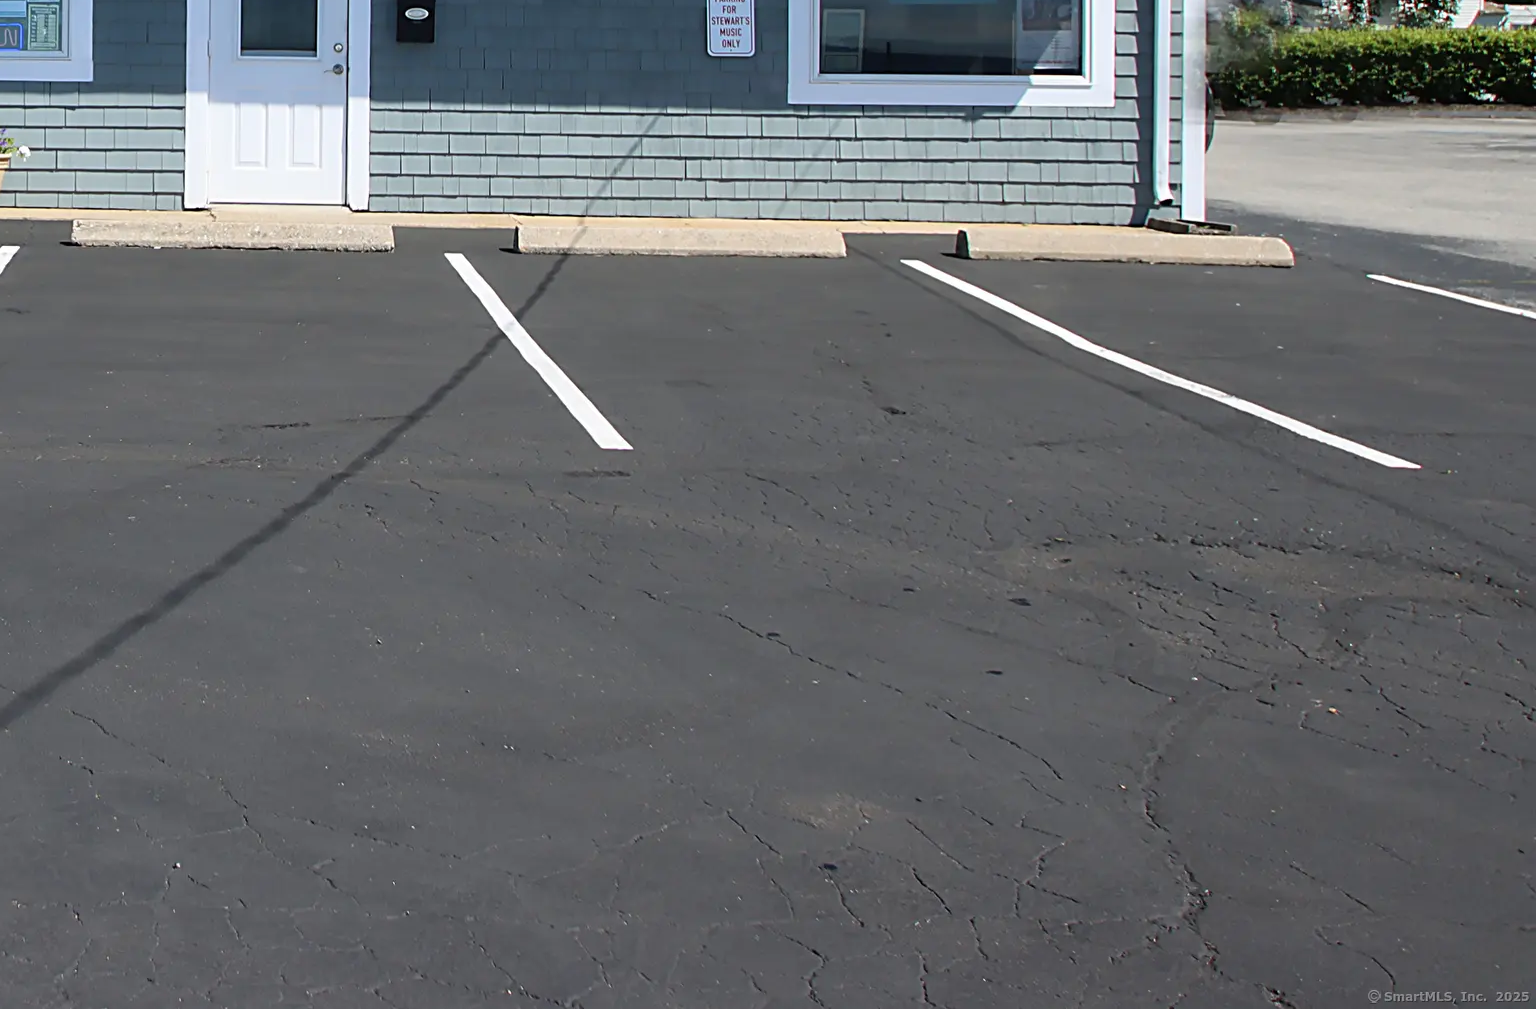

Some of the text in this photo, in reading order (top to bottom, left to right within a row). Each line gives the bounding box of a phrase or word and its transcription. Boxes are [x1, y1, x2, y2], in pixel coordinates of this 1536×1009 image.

[722, 6, 736, 14] FOR
[712, 16, 750, 25] STEWART'S
[720, 28, 742, 36] MUSIC
[722, 40, 740, 48] ONLY
